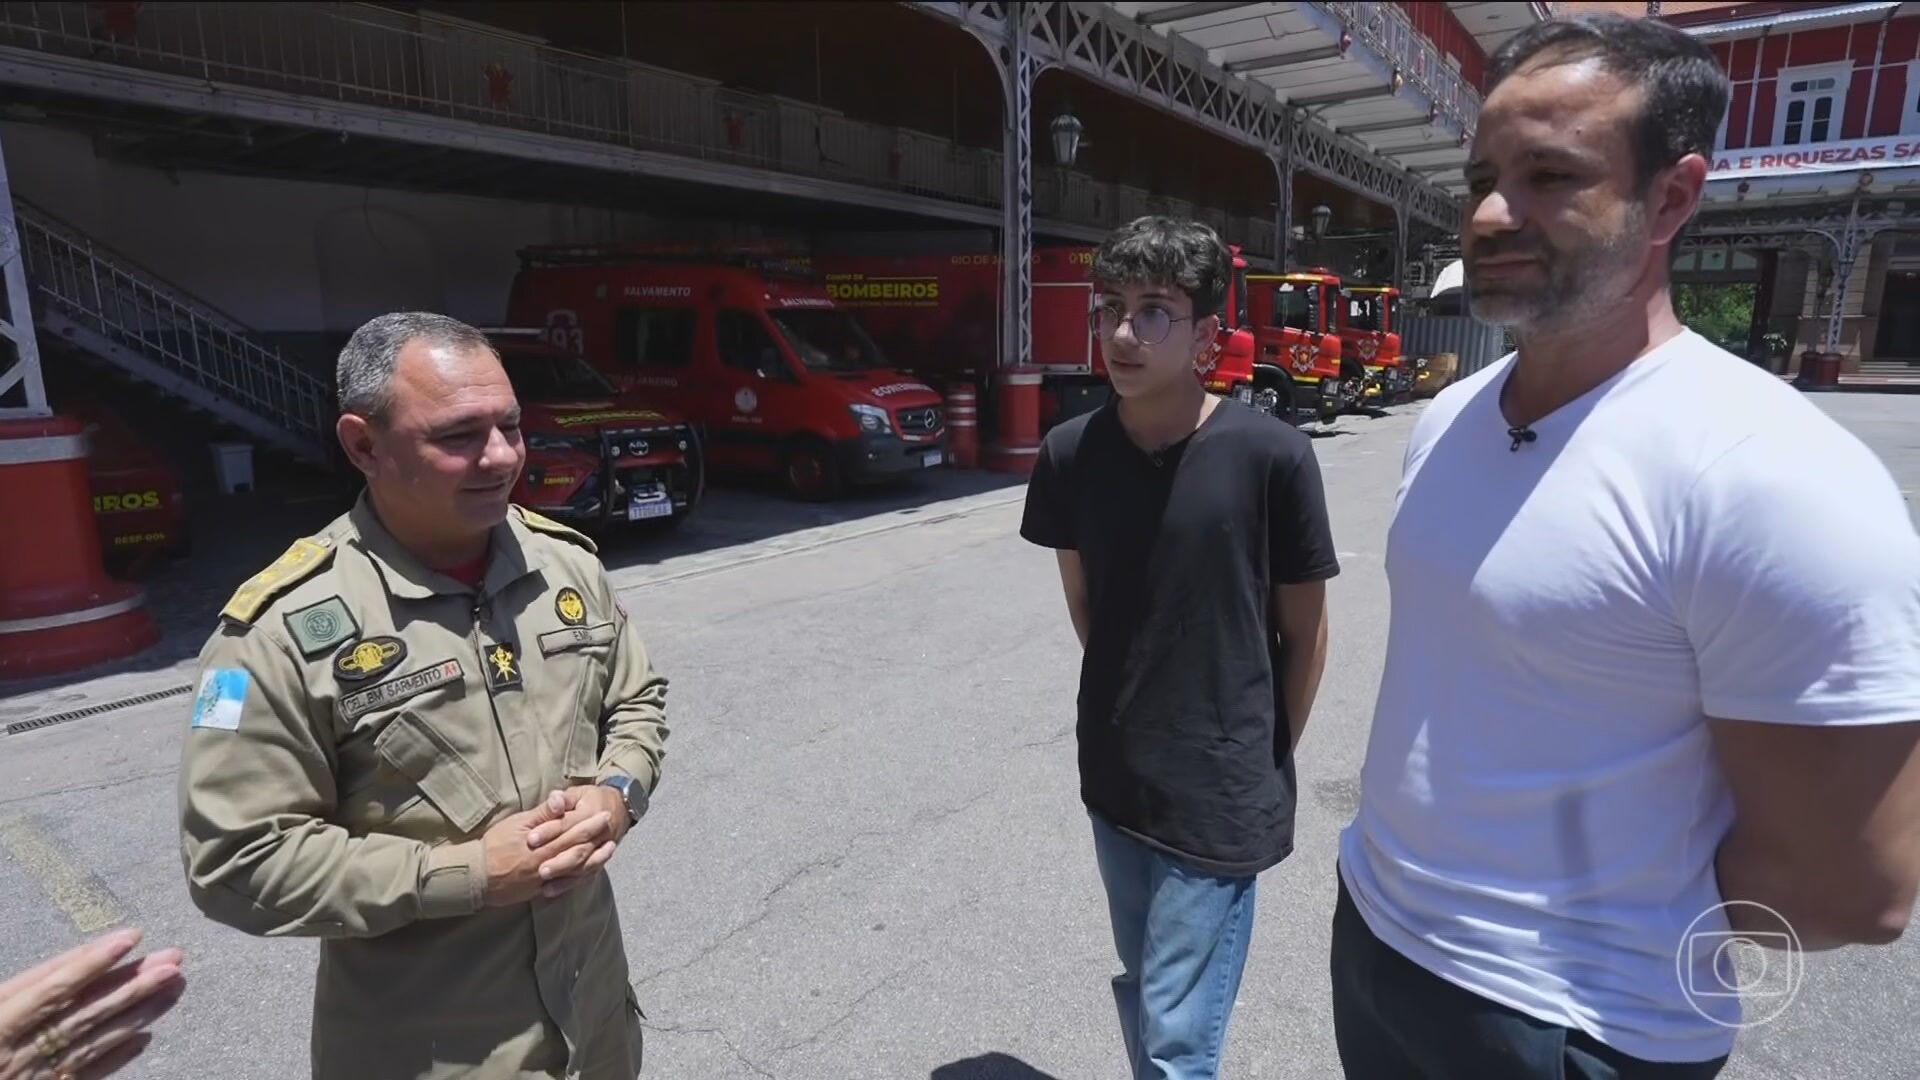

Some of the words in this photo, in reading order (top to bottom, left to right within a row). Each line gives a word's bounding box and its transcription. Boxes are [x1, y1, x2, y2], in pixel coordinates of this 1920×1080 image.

[1739, 156, 1753, 169] E
[1760, 144, 1886, 168] RIQUEZAS
[951, 255, 971, 264] RIO
[974, 255, 989, 264] DE
[624, 285, 691, 297] SALVAMENTO
[825, 282, 940, 299] BOMBEIROS
[93, 490, 160, 512] IROS
[367, 690, 386, 704] BM
[386, 668, 441, 698] SARMENTO
[443, 662, 457, 676] A+
